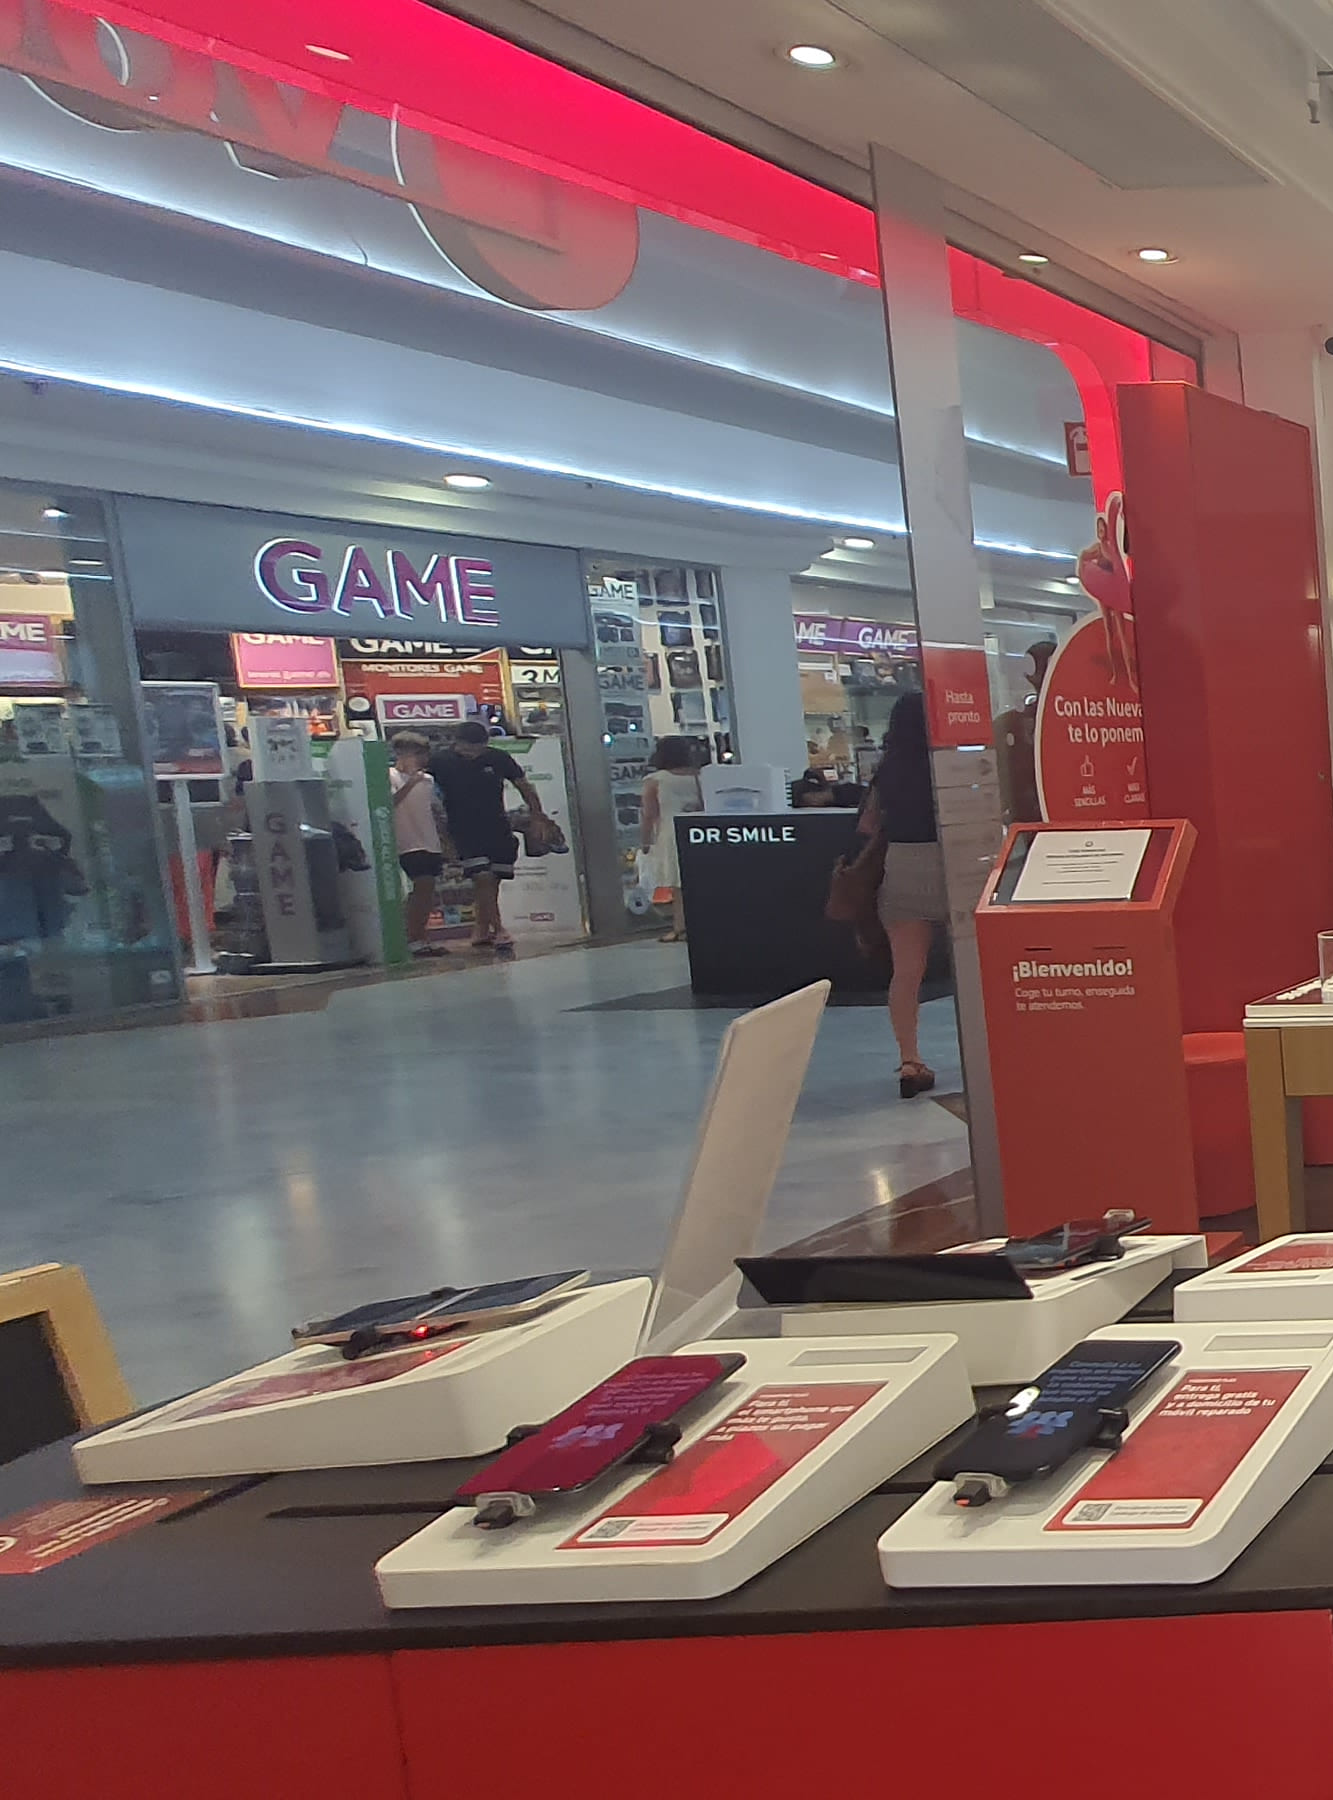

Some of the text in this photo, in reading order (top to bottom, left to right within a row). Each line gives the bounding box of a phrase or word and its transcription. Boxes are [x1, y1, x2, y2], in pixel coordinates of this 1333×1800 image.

[254, 537, 501, 627] GAME
[600, 674, 646, 691] GAME
[945, 690, 974, 704] Hasta
[393, 703, 455, 719] GAME
[1055, 695, 1081, 717] Con
[1084, 696, 1105, 717] las
[947, 711, 980, 725] pronto
[1068, 723, 1083, 743] te
[1085, 723, 1099, 743] lo
[689, 826, 796, 844] DR SMILE
[1013, 958, 1134, 983] ¡Bienvenido!
[1015, 986, 1041, 999] Coge
[1042, 986, 1053, 998] tu
[1181, 1384, 1208, 1392] Para
[1174, 1391, 1258, 1401] entrega gratis
[1244, 1399, 1260, 1407] de
[1262, 1399, 1276, 1407] tu
[1196, 1408, 1252, 1416] reparado
